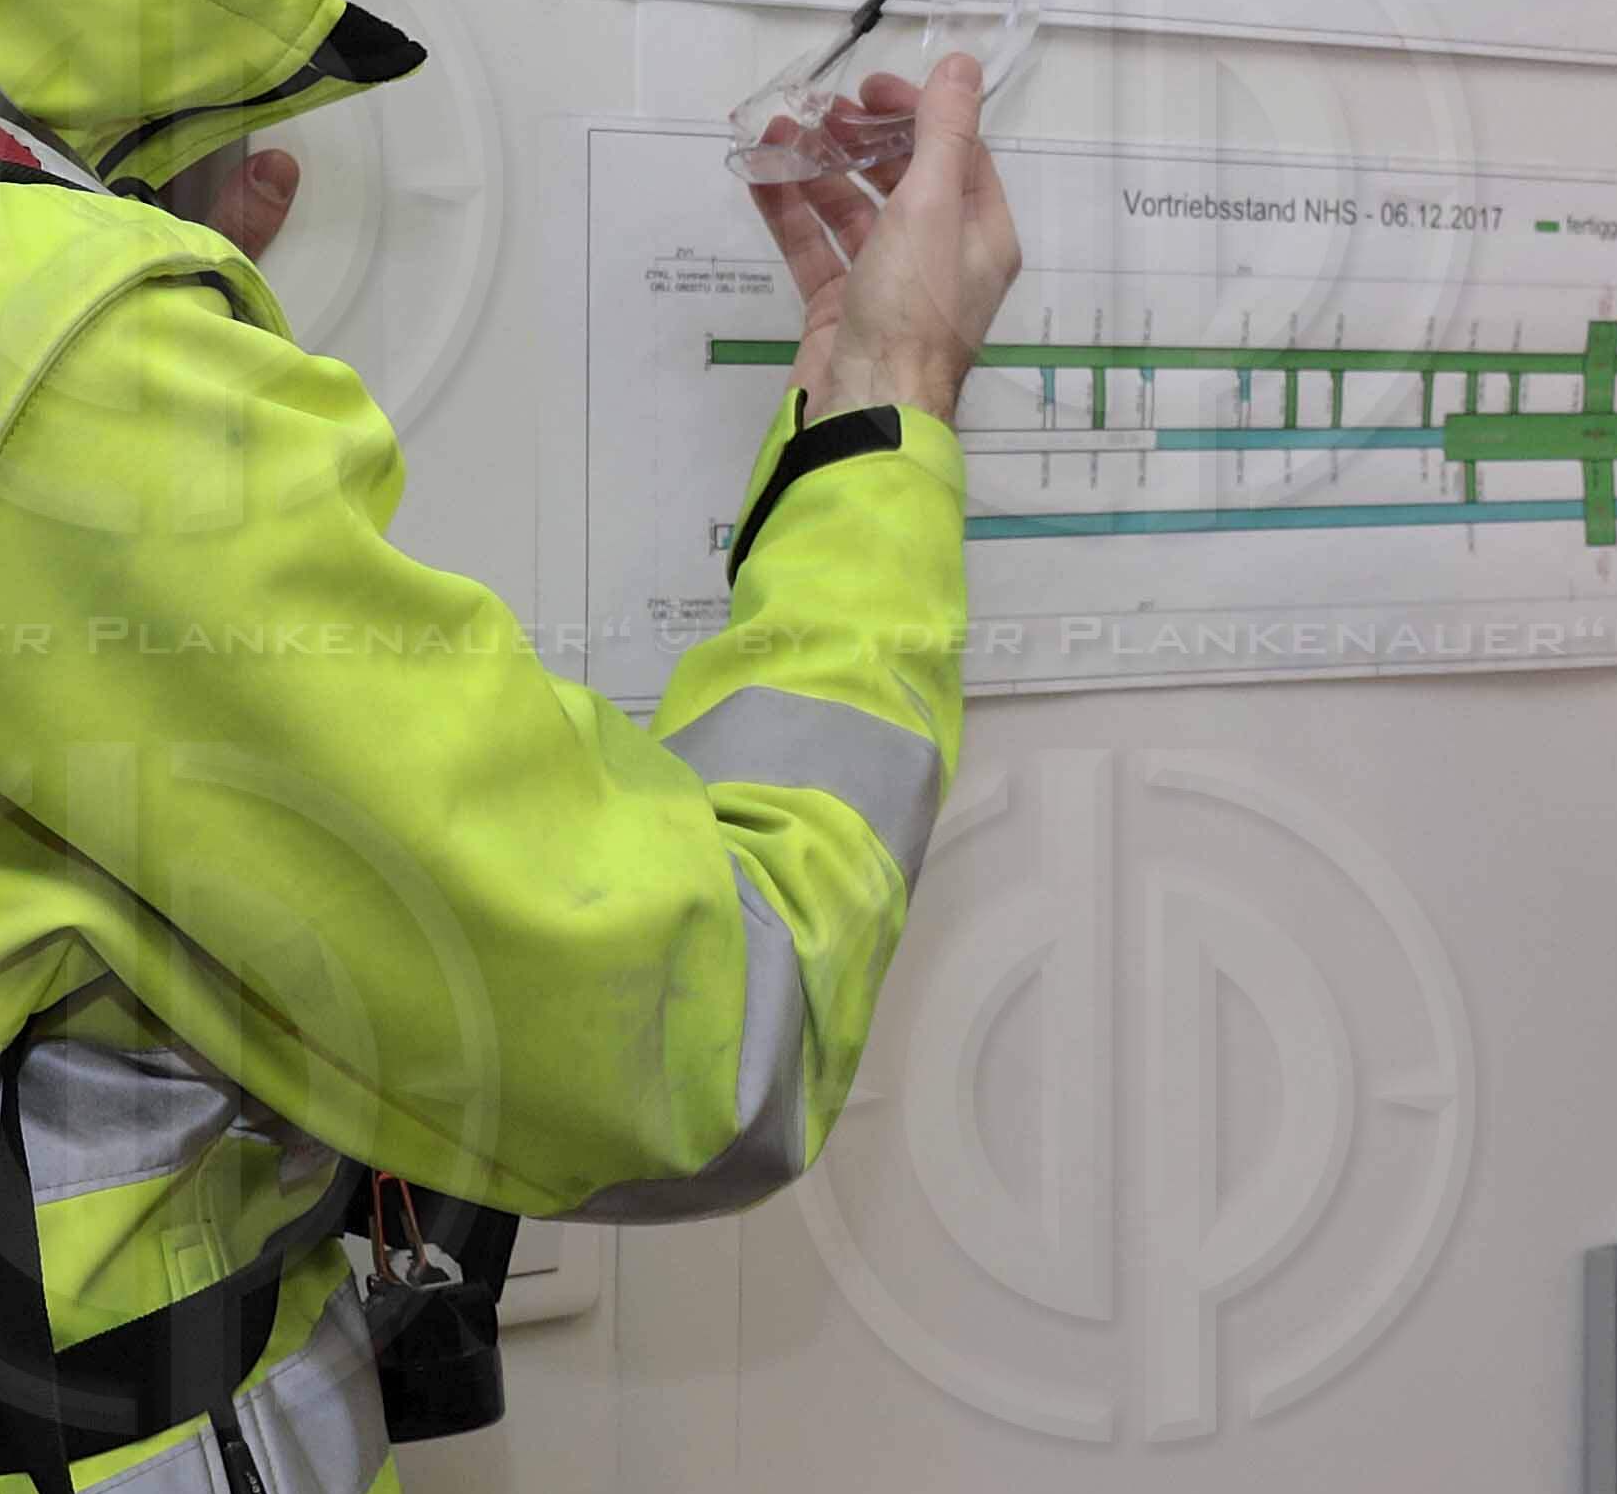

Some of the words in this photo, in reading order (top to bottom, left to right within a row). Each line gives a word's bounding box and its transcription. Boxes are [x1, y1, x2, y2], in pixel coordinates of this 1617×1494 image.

[1123, 188, 1296, 223] Vortriebsstand
[1304, 198, 1358, 226] NHS
[1380, 202, 1504, 231] 06.12.2017
